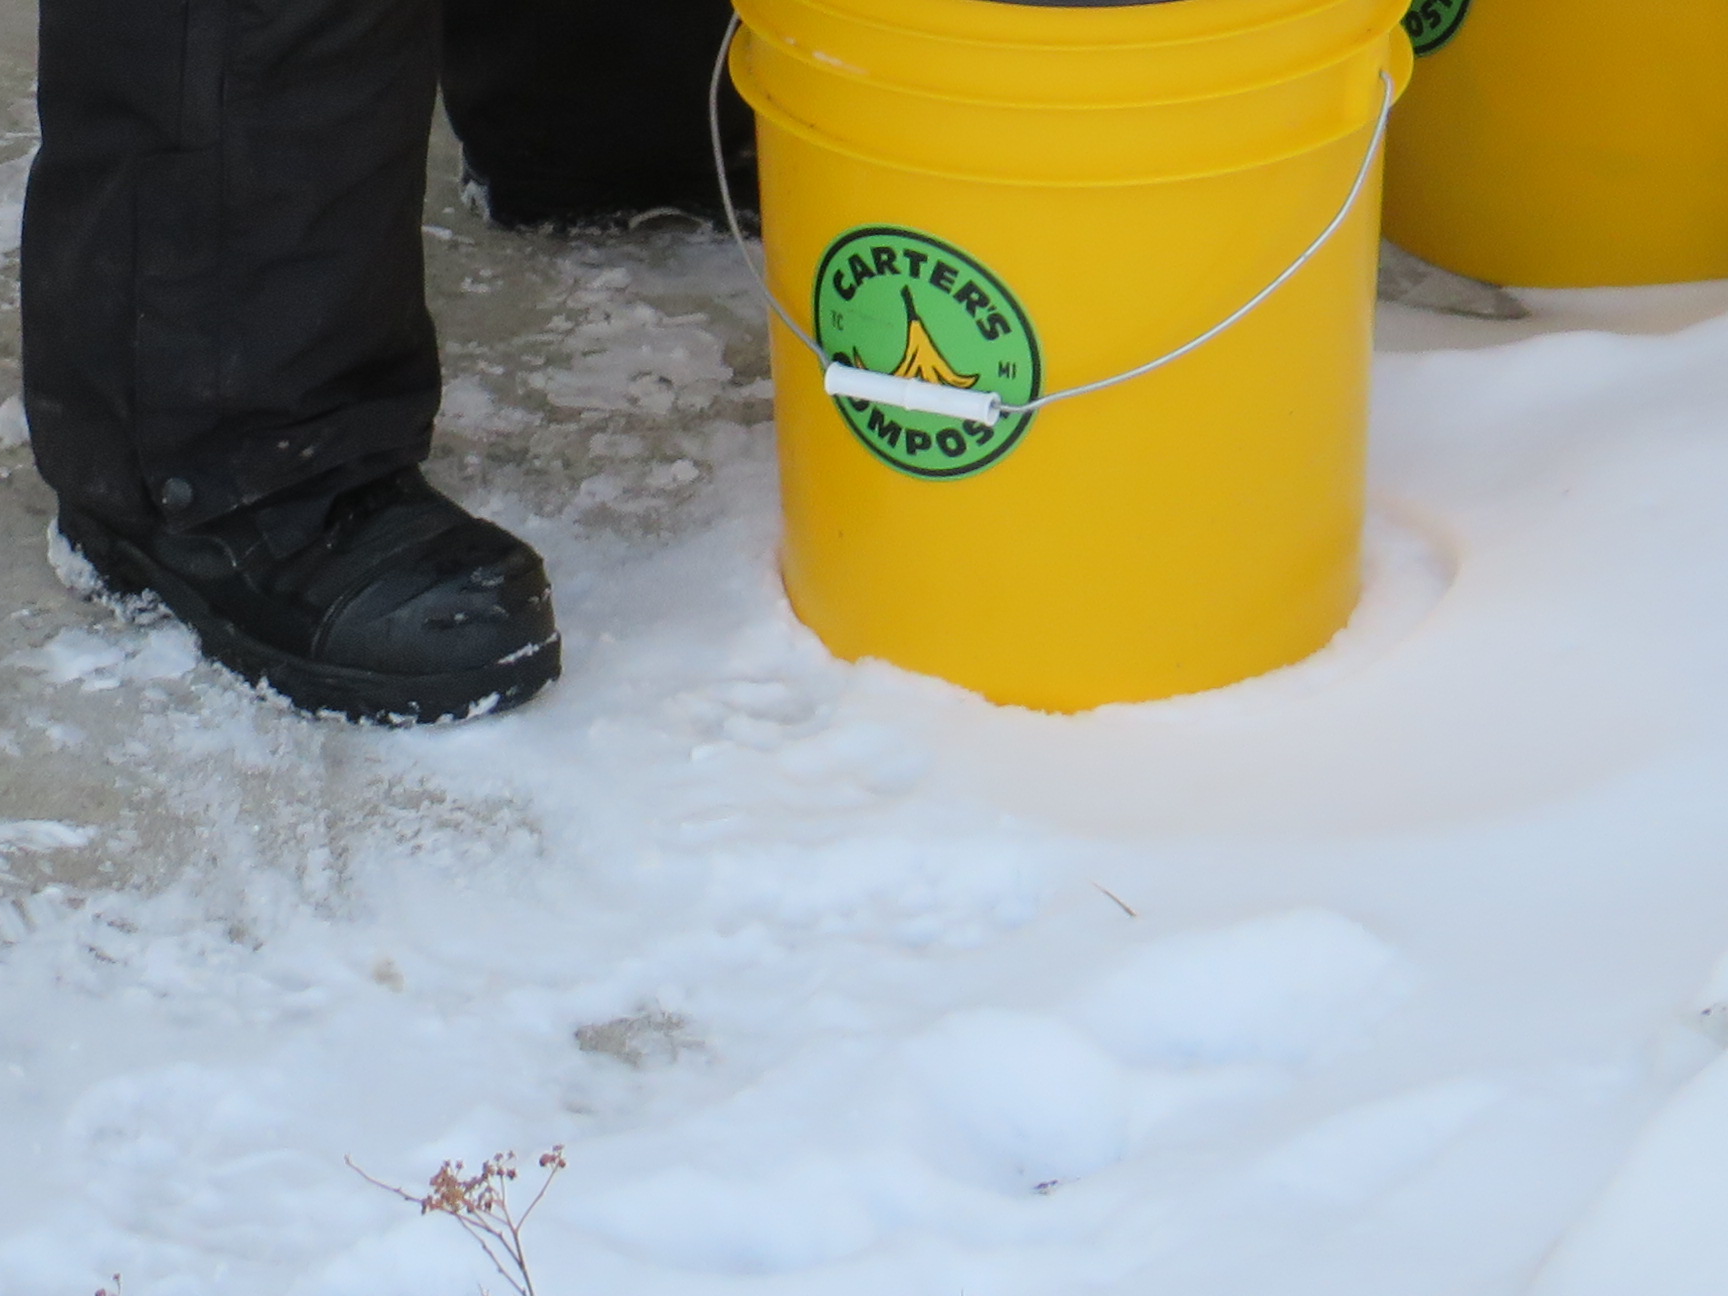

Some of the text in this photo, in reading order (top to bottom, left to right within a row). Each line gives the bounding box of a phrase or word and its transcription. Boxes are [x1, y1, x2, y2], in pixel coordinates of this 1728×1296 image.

[832, 246, 1012, 341] CARTER'S
[832, 351, 1010, 458] MPOS
[998, 360, 1017, 380] MI
